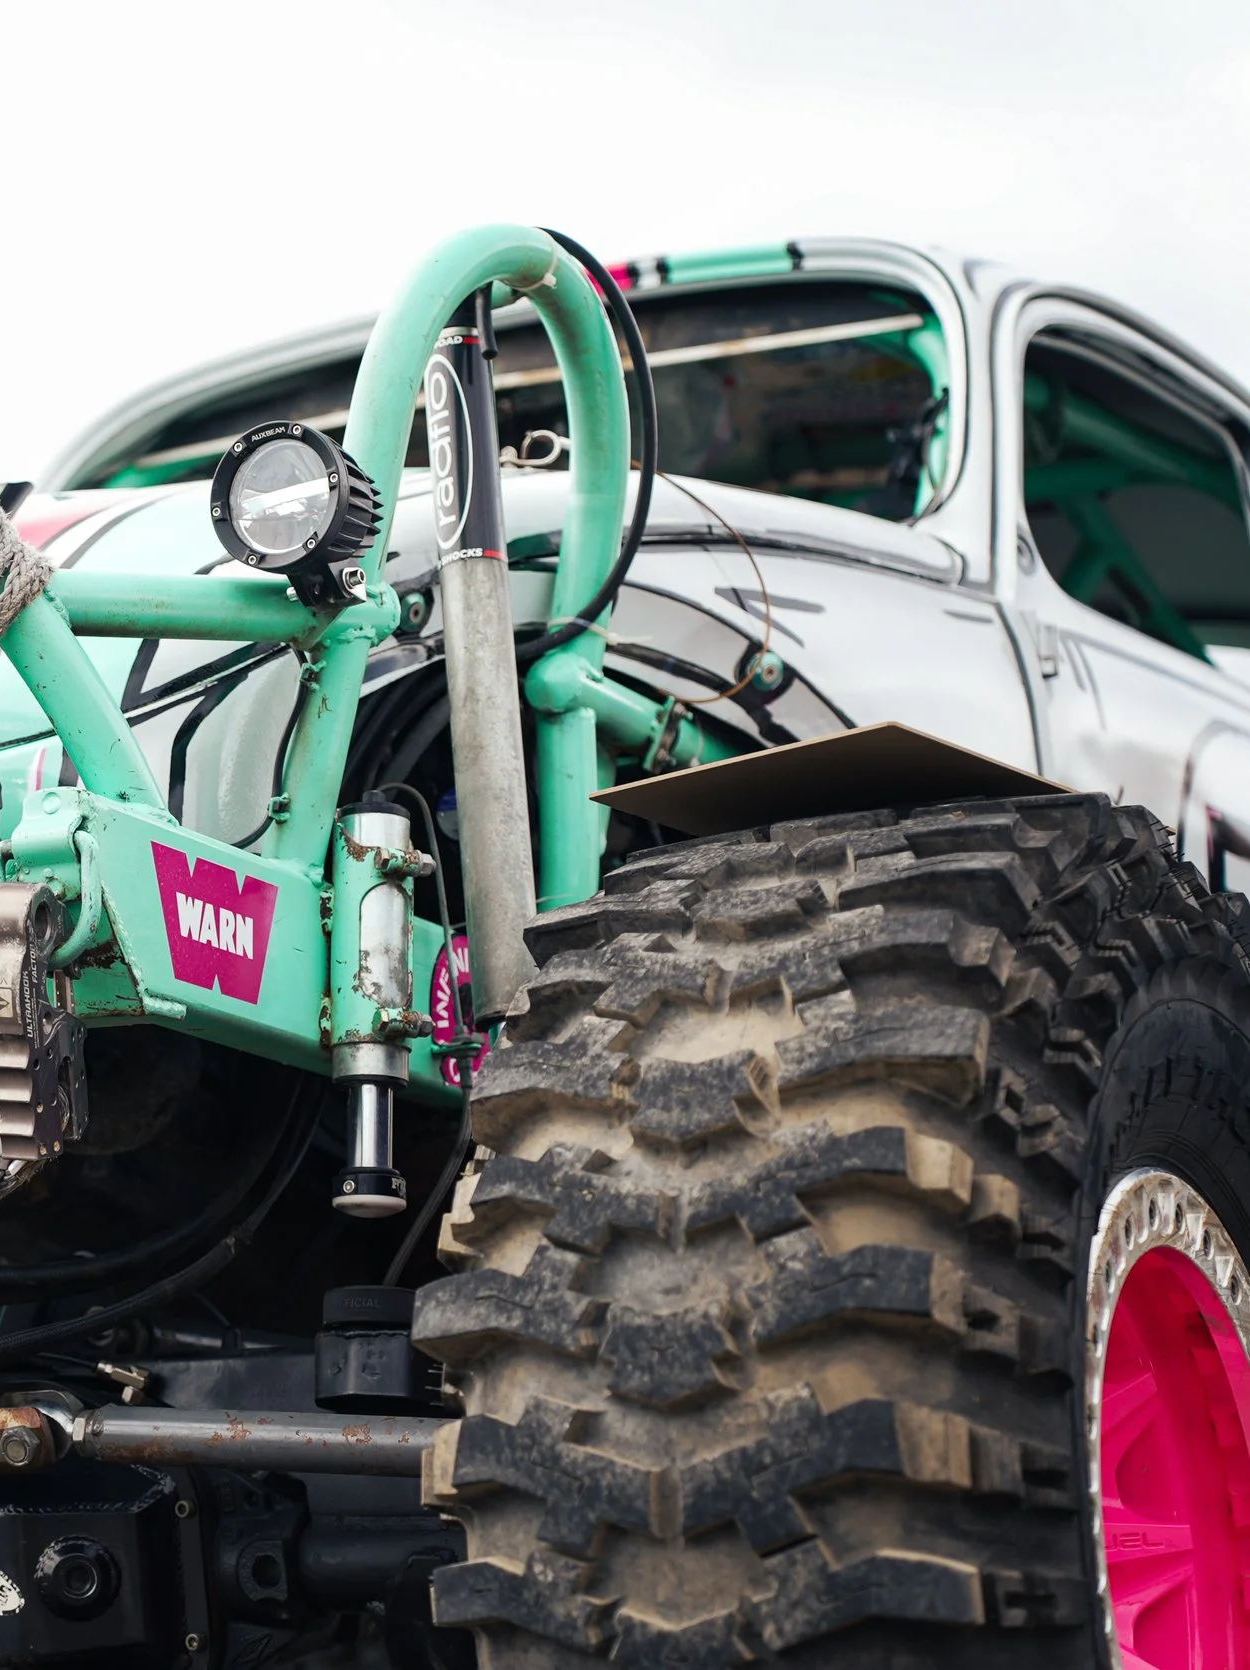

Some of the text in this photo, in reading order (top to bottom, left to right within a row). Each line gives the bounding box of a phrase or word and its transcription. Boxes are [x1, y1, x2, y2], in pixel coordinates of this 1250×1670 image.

[251, 426, 286, 443] AUXBEAM
[430, 371, 457, 528] radflo
[176, 891, 254, 960] WARN
[23, 971, 33, 1038] ULTRAHOOK
[1105, 1532, 1165, 1551] UEL
